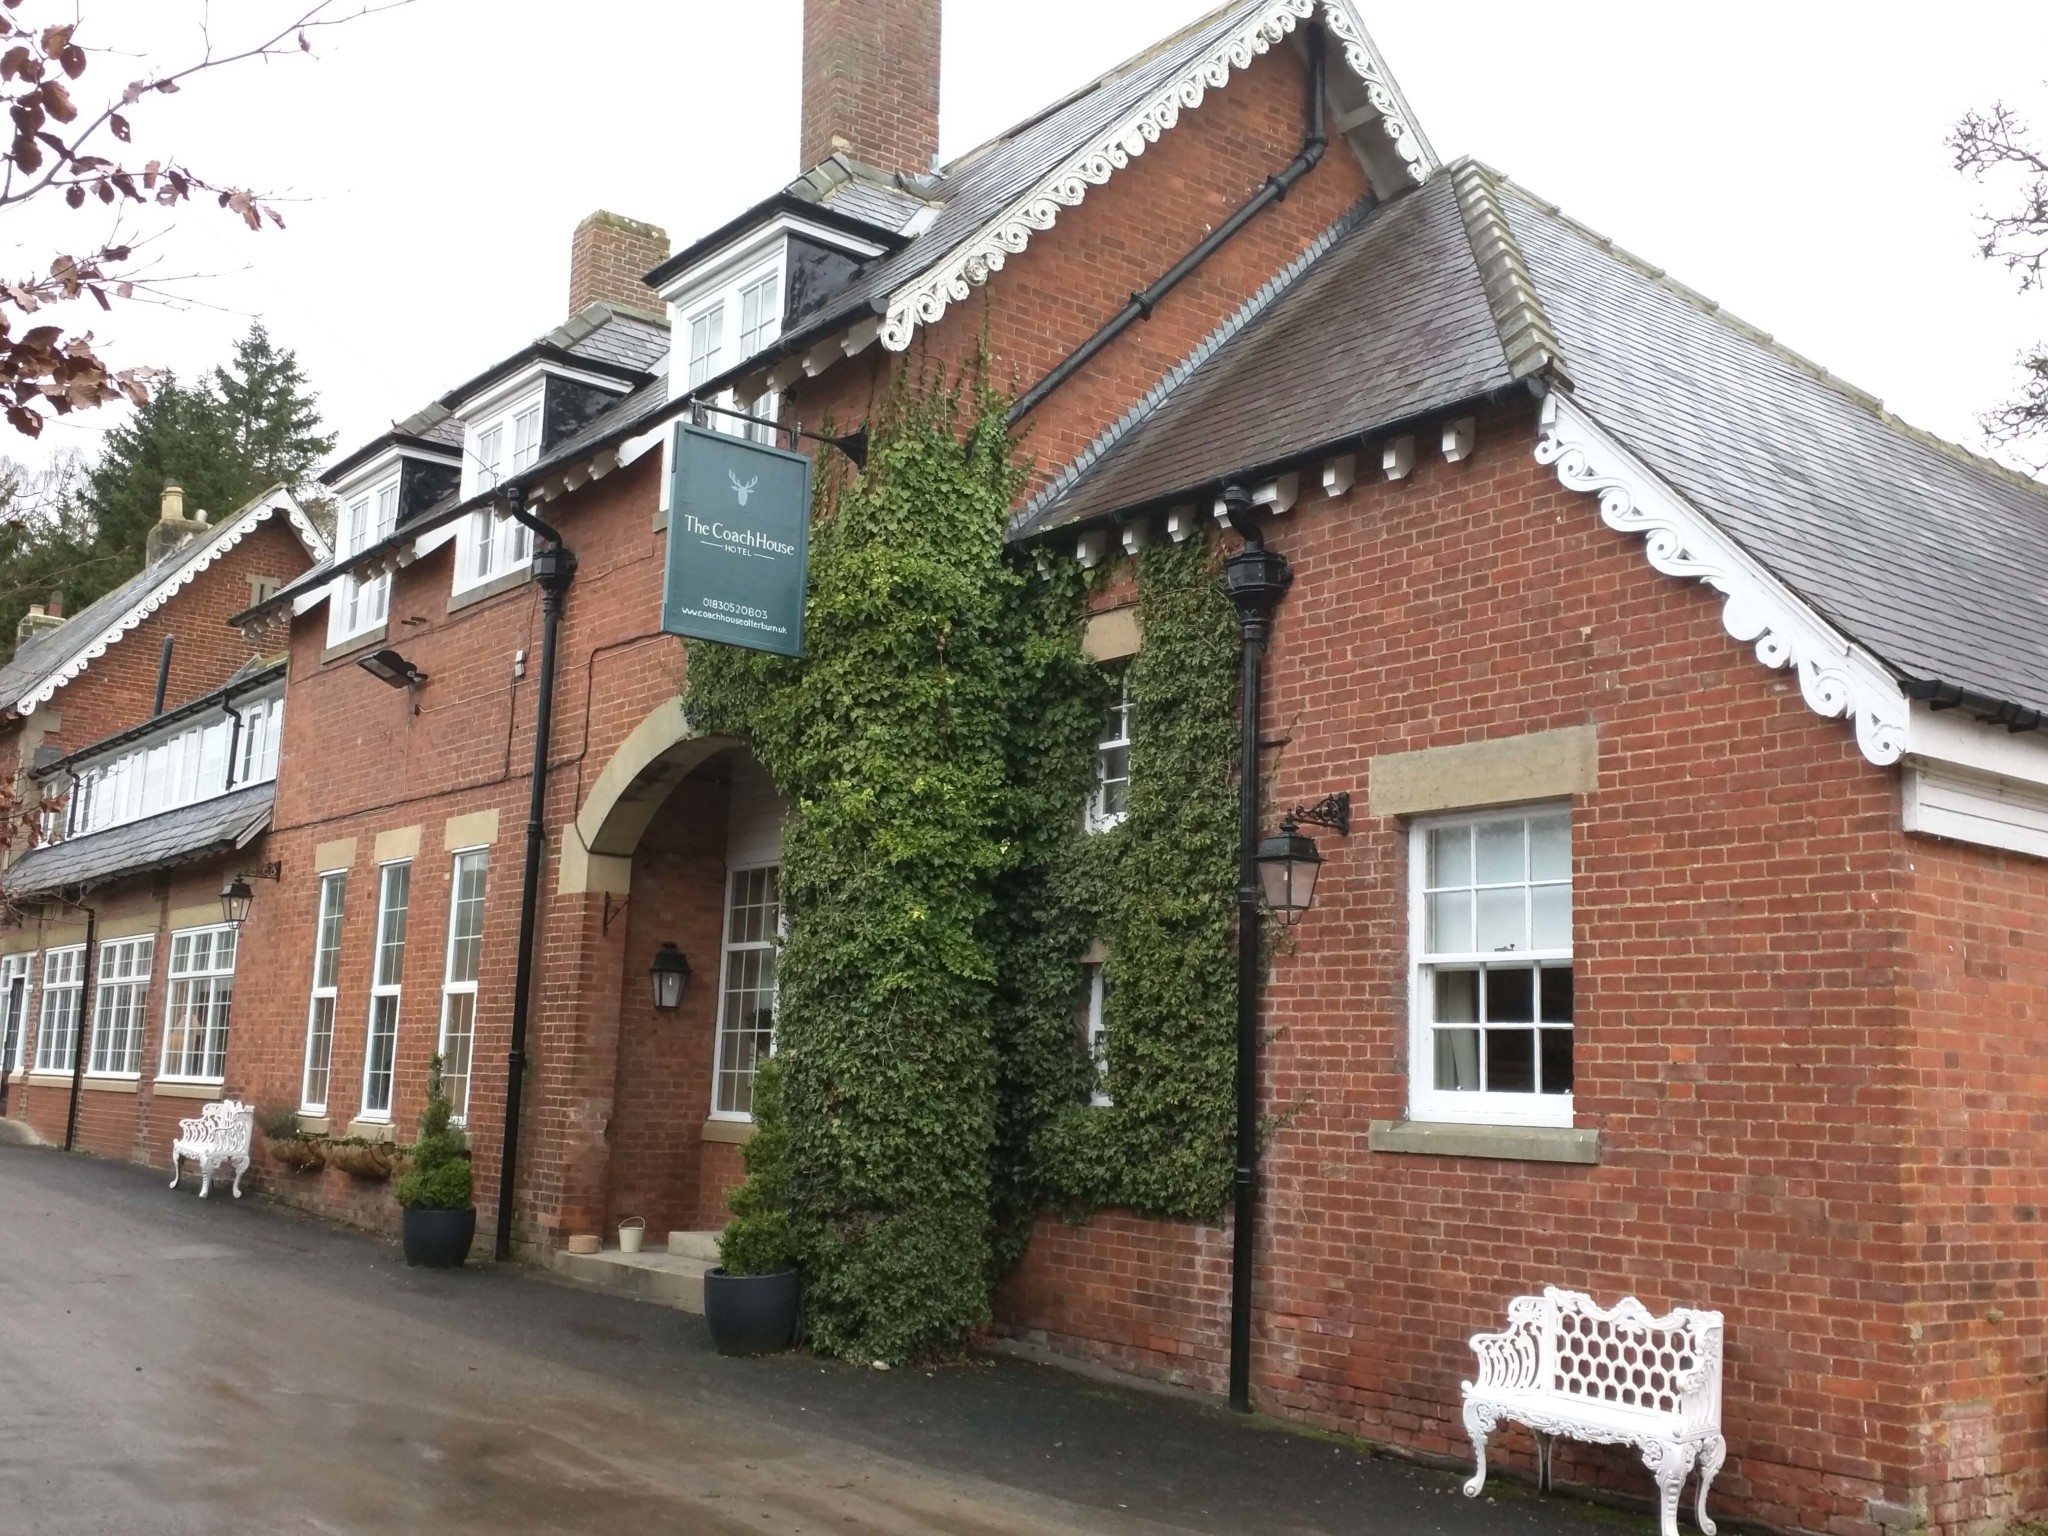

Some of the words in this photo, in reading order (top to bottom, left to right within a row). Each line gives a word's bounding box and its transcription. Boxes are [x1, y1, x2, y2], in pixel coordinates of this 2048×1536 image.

[685, 514, 710, 536] The
[724, 544, 752, 557] HOTEL
[702, 597, 768, 620] 01830520803
